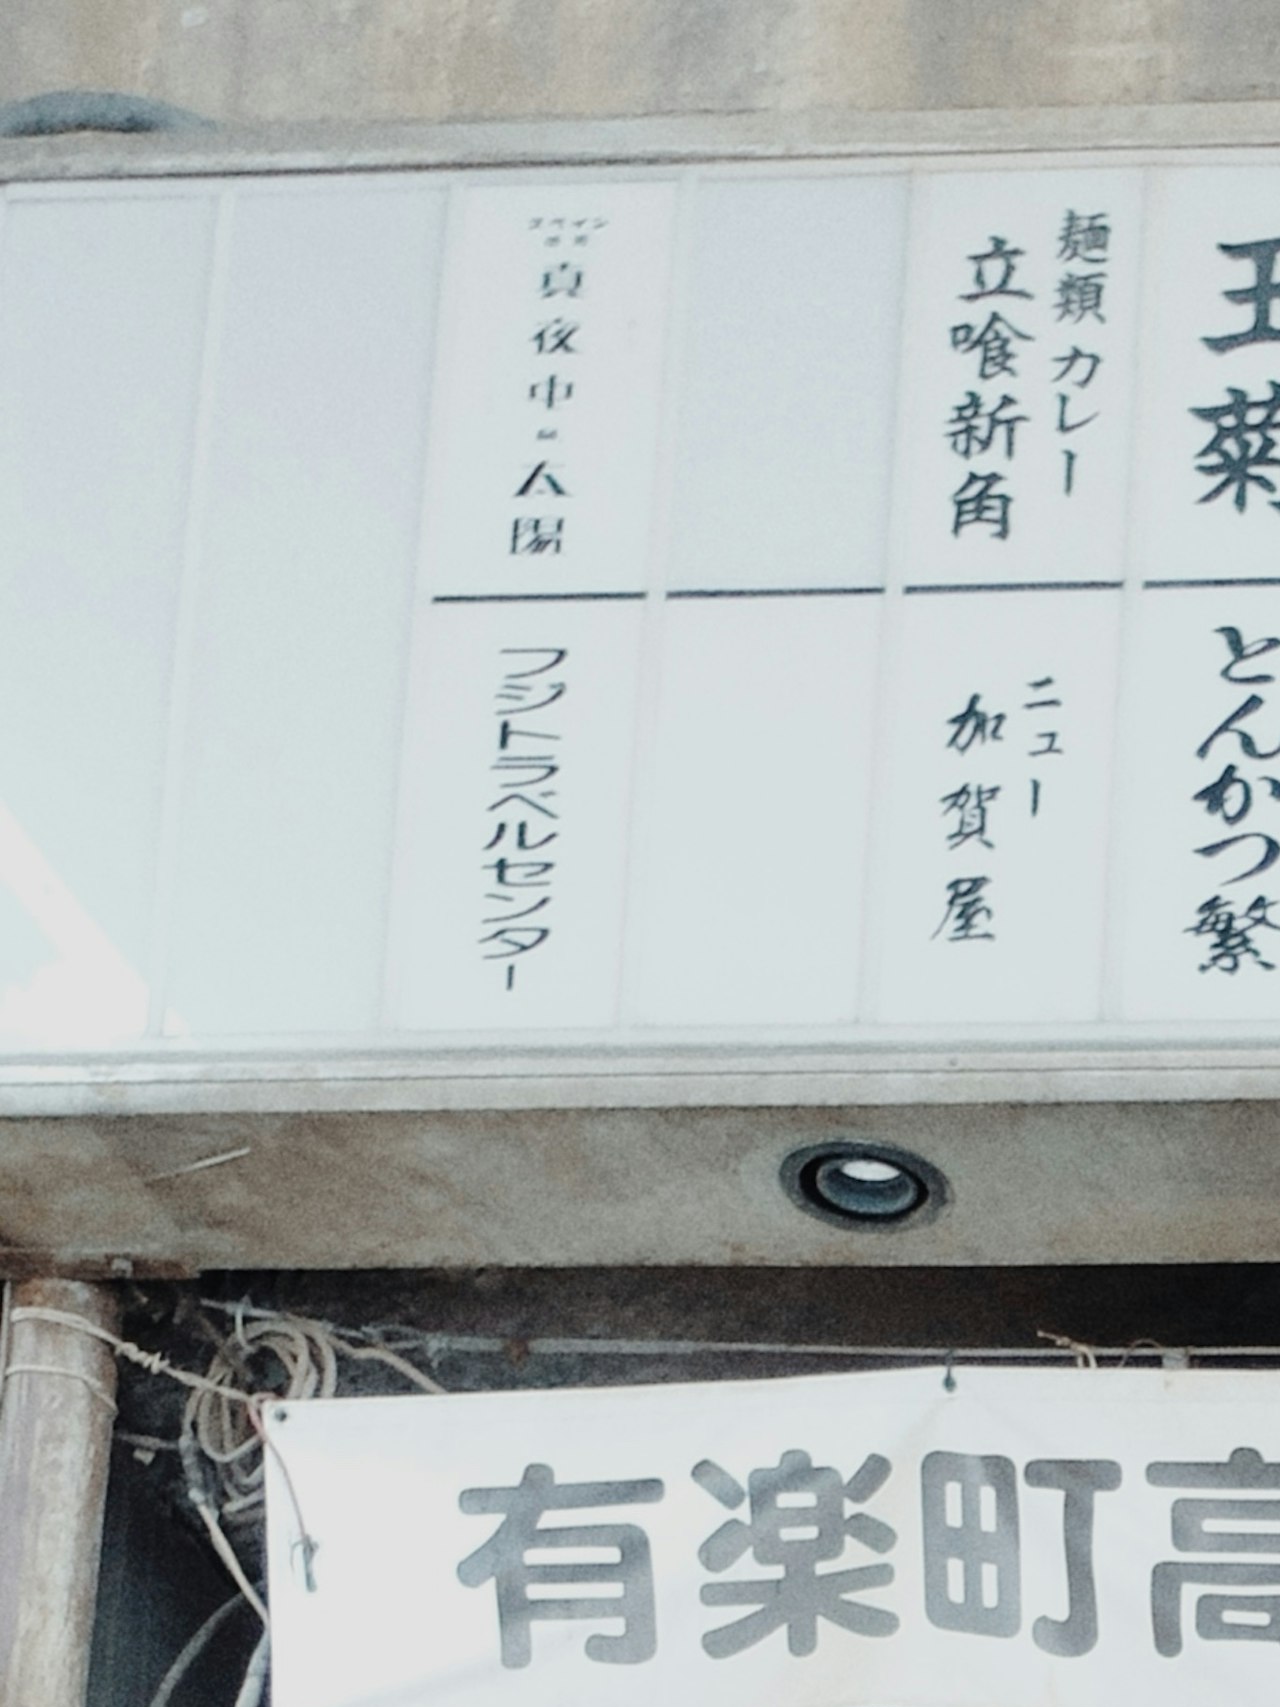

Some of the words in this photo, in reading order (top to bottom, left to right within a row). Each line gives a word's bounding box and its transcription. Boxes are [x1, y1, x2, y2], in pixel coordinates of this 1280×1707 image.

[944, 235, 1035, 541] 立喰新角
[1052, 209, 1112, 496] 麺類カレー
[478, 648, 568, 991] フジトラベルセンター
[932, 692, 1007, 942] 加賀屋
[1023, 676, 1063, 817] ニュー
